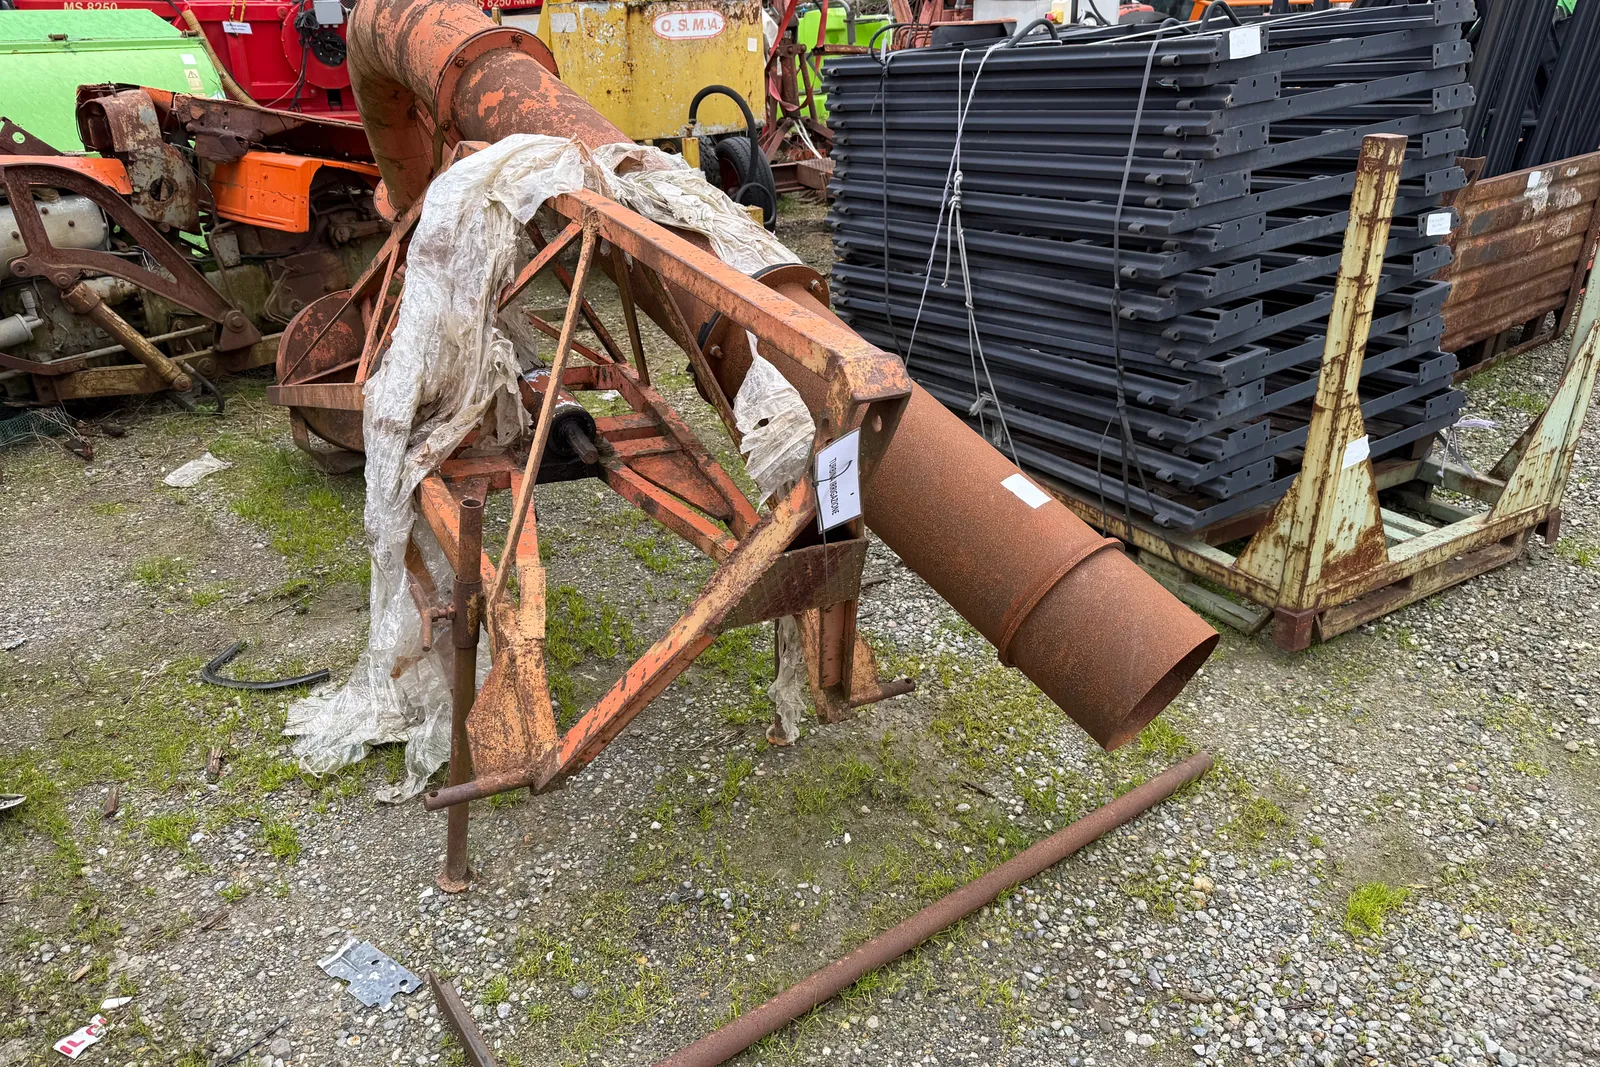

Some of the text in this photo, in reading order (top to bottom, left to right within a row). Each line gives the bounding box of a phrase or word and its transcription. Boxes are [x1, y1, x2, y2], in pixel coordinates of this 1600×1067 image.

[63, 2, 118, 10] MS 8250
[829, 481, 840, 516] IRRIGAZIONE
